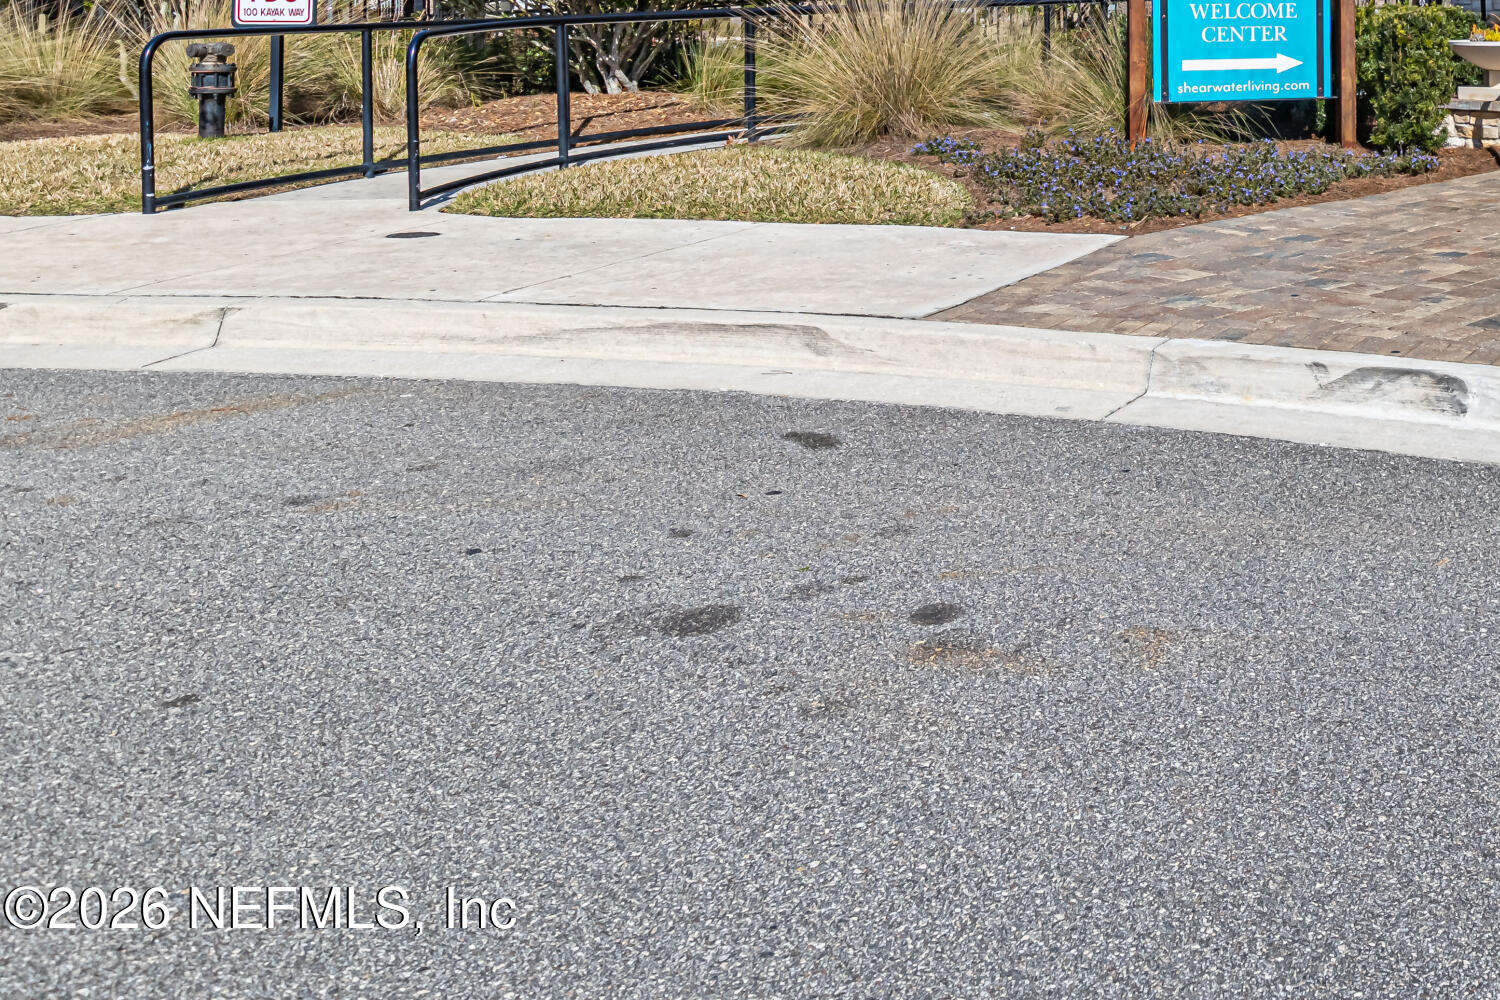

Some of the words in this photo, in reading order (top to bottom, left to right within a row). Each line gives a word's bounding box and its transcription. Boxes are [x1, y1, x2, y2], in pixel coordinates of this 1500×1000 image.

[243, 7, 258, 17] 100
[260, 7, 285, 17] KAYAK
[288, 7, 305, 17] WAY
[1190, 2, 1297, 19] WELCOME
[1201, 25, 1288, 42] CENTER
[1177, 80, 1310, 95] shearwaterliving.com
